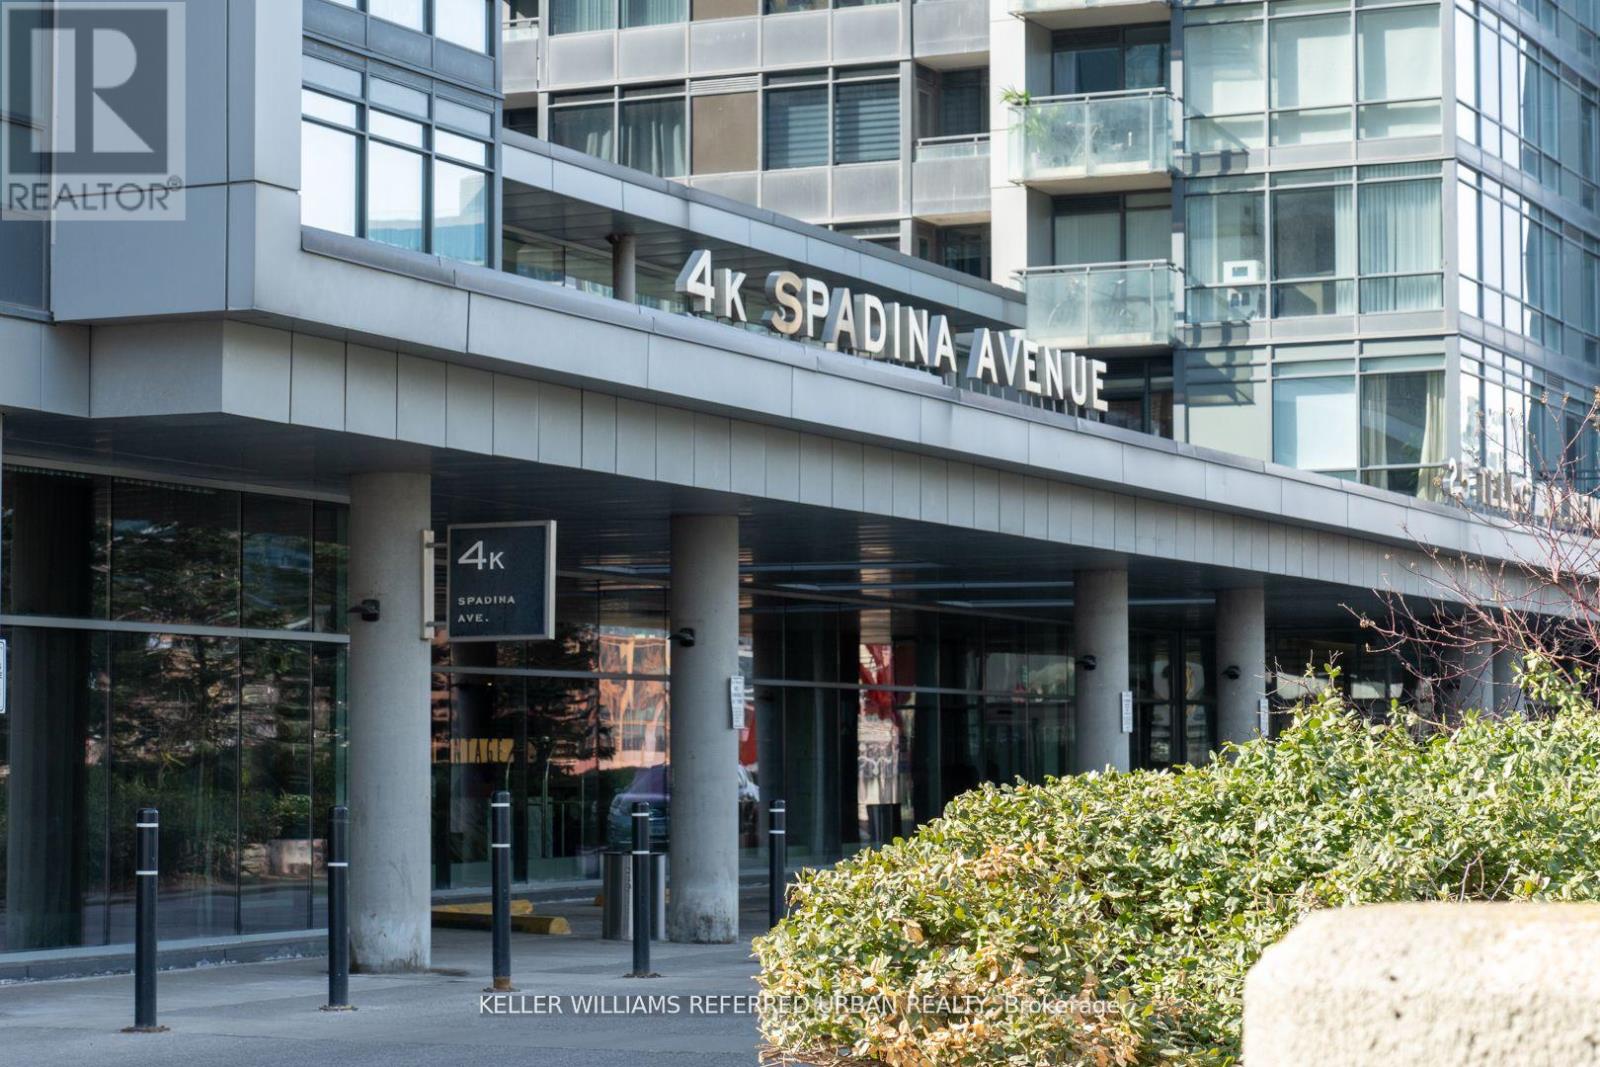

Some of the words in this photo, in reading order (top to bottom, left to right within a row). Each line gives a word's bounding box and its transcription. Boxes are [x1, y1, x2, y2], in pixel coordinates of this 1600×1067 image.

[675, 249, 748, 322] 4K
[762, 270, 957, 373] SPADINA
[967, 328, 1109, 412] AVENUE
[457, 540, 505, 570] 4K
[457, 595, 516, 606] SPADINA
[457, 613, 489, 623] AVE.
